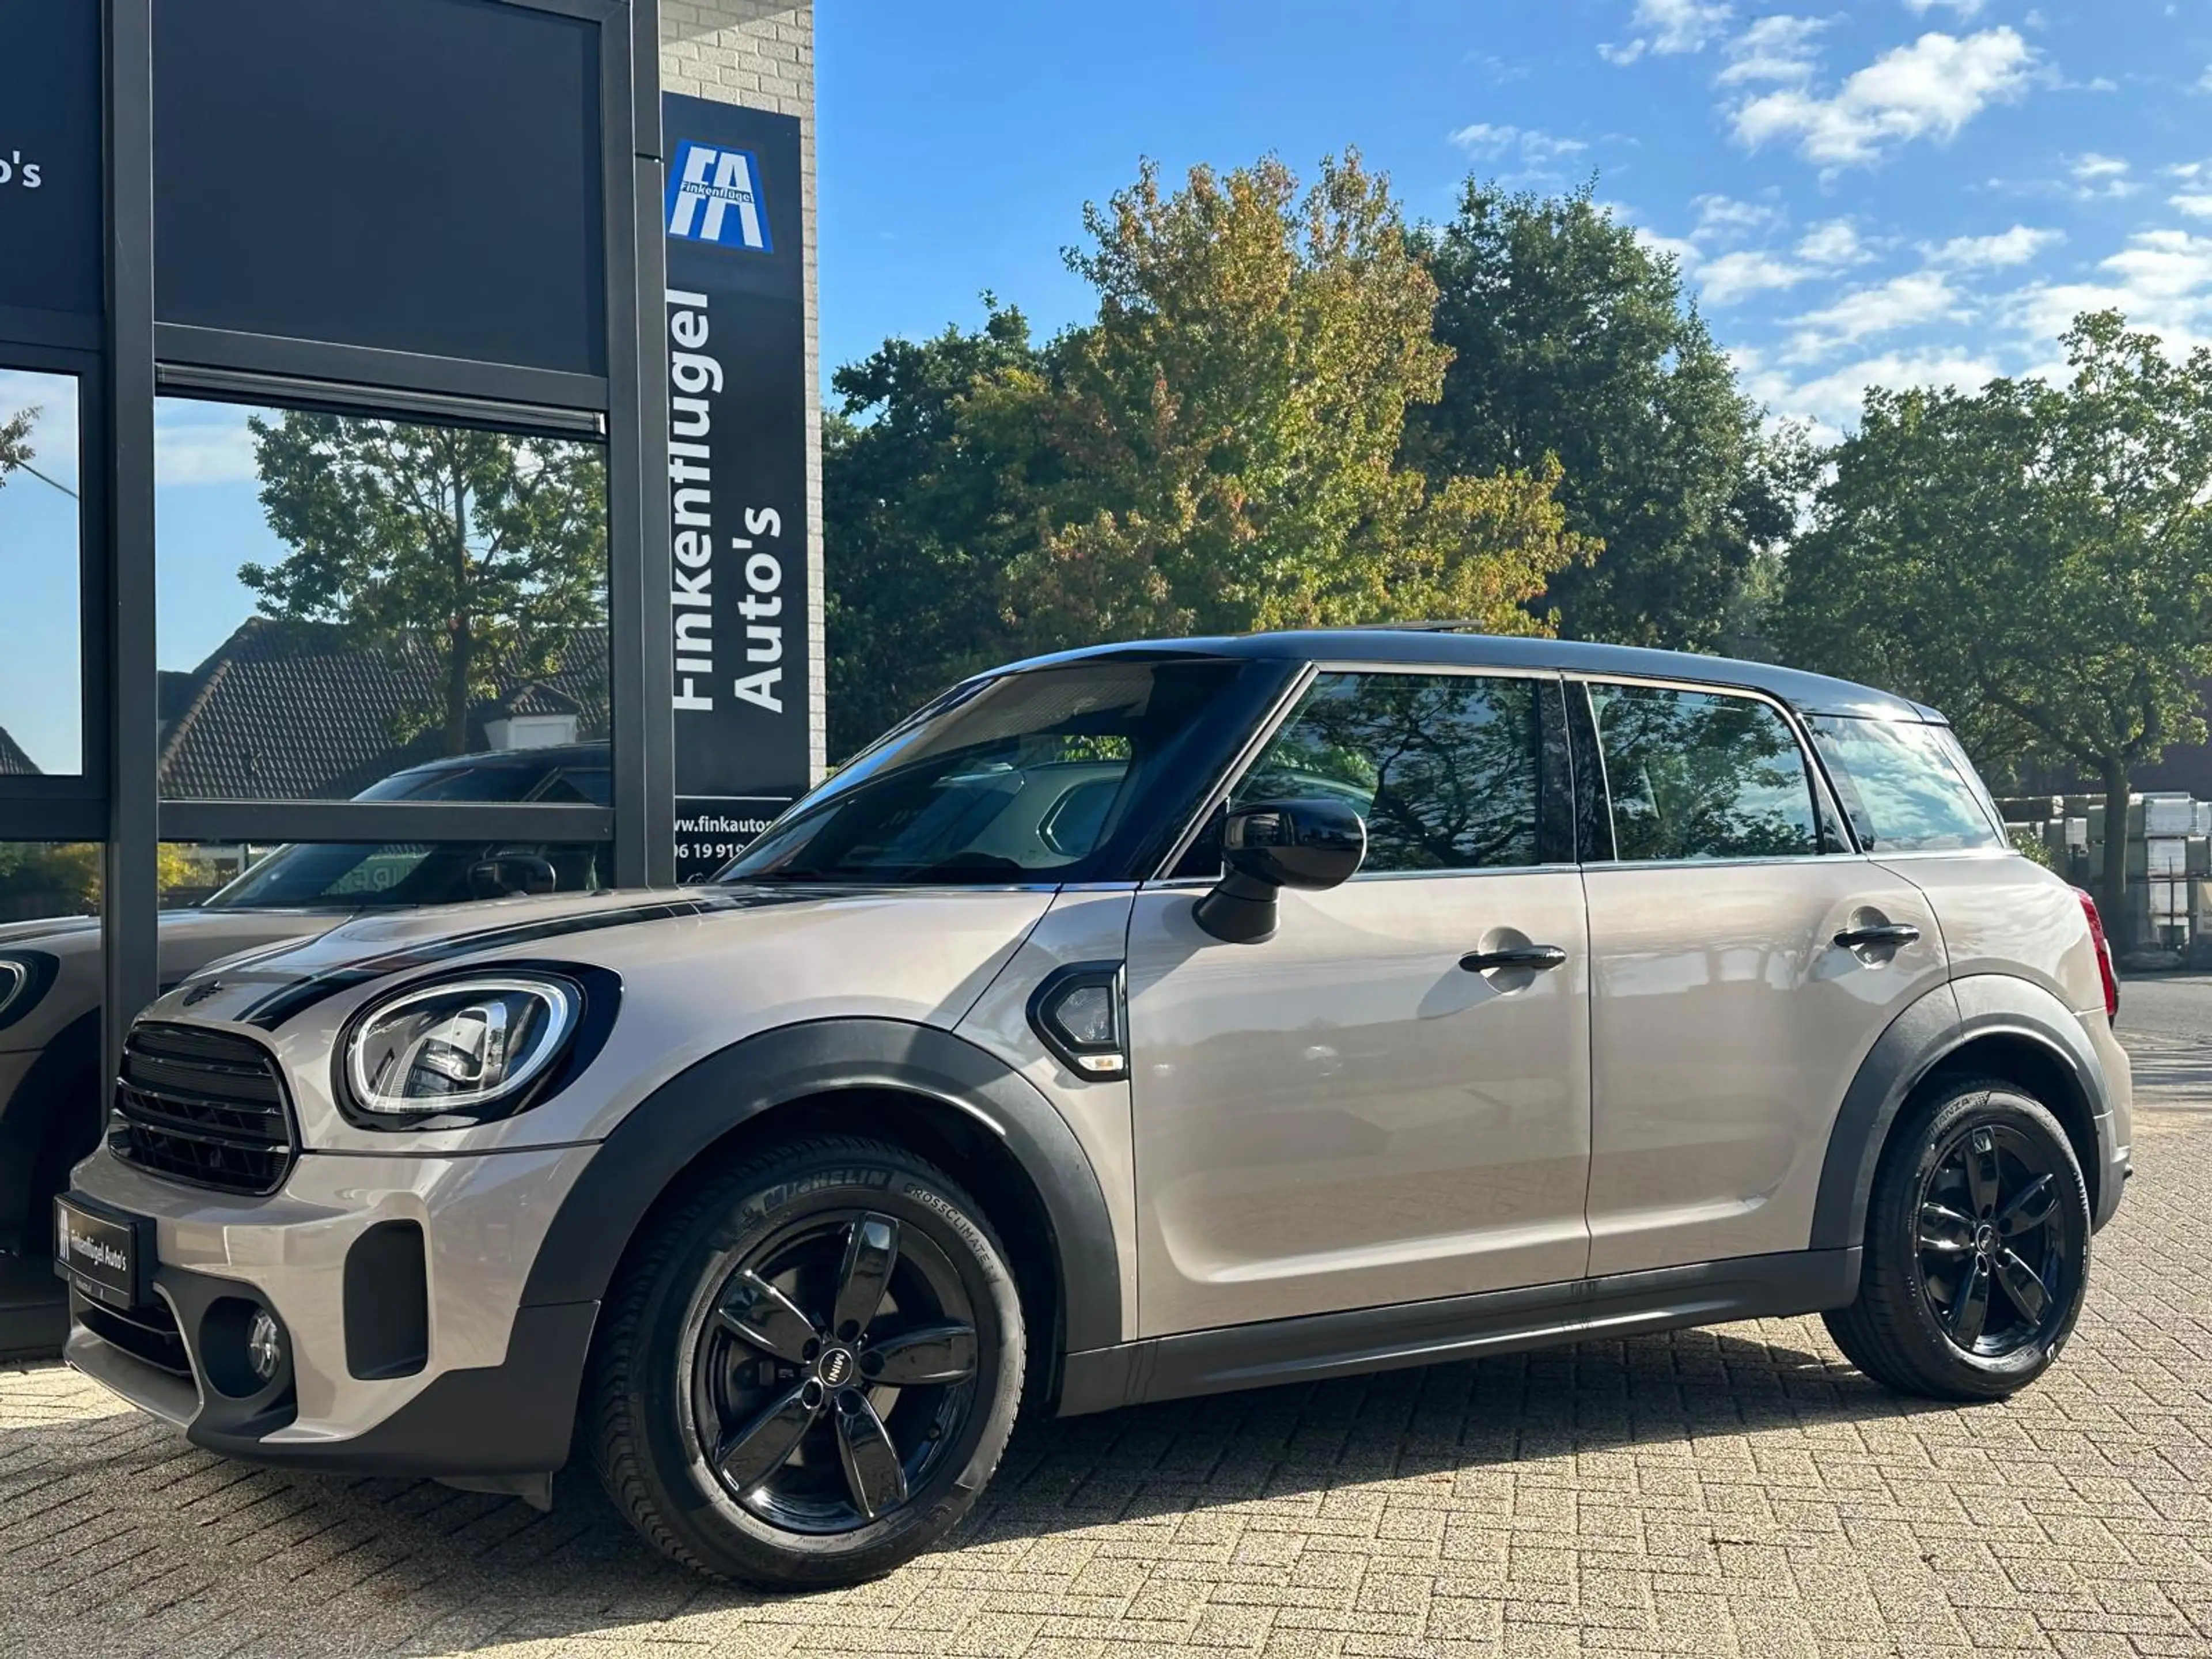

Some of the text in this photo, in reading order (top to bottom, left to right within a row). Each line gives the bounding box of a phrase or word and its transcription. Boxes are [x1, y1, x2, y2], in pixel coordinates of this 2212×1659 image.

[732, 506, 782, 713] Auto's
[694, 843, 713, 858] 19
[828, 1353, 845, 1381] MINI
